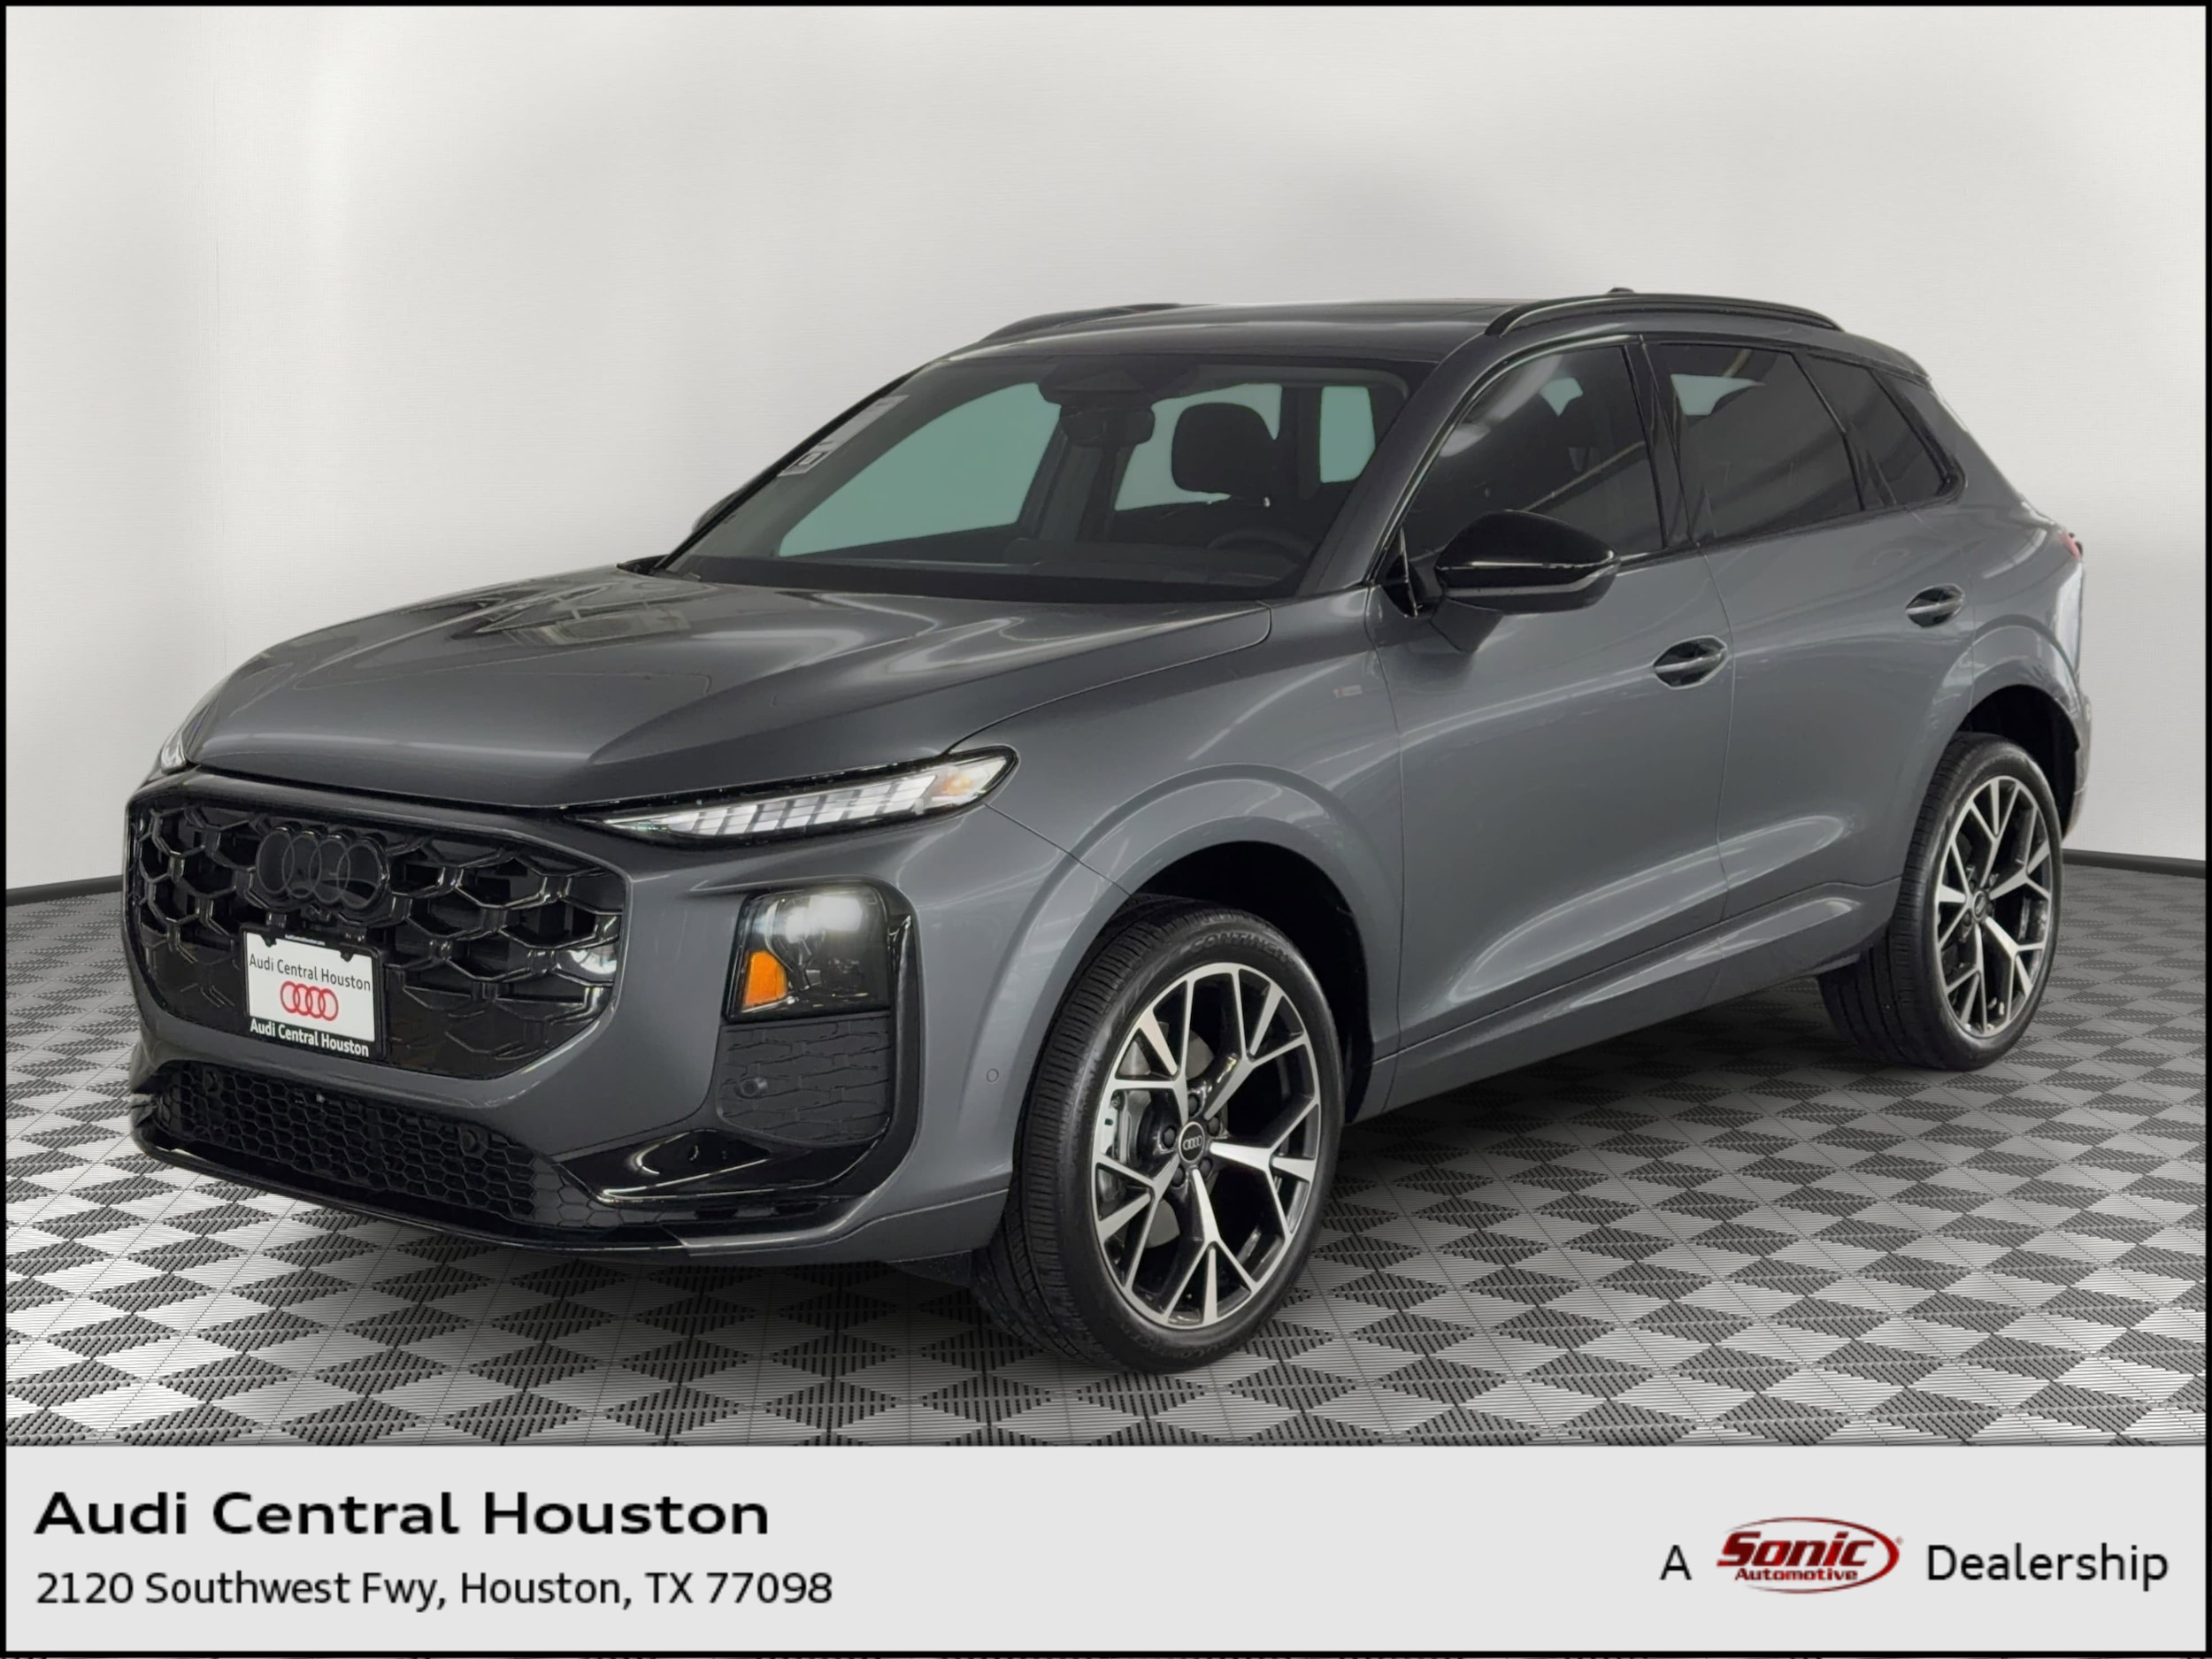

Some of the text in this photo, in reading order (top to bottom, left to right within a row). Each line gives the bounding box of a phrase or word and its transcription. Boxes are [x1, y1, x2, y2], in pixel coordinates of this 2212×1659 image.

[250, 954, 371, 992] Audi Central Houston
[250, 1018, 369, 1057] Audi Central Houston
